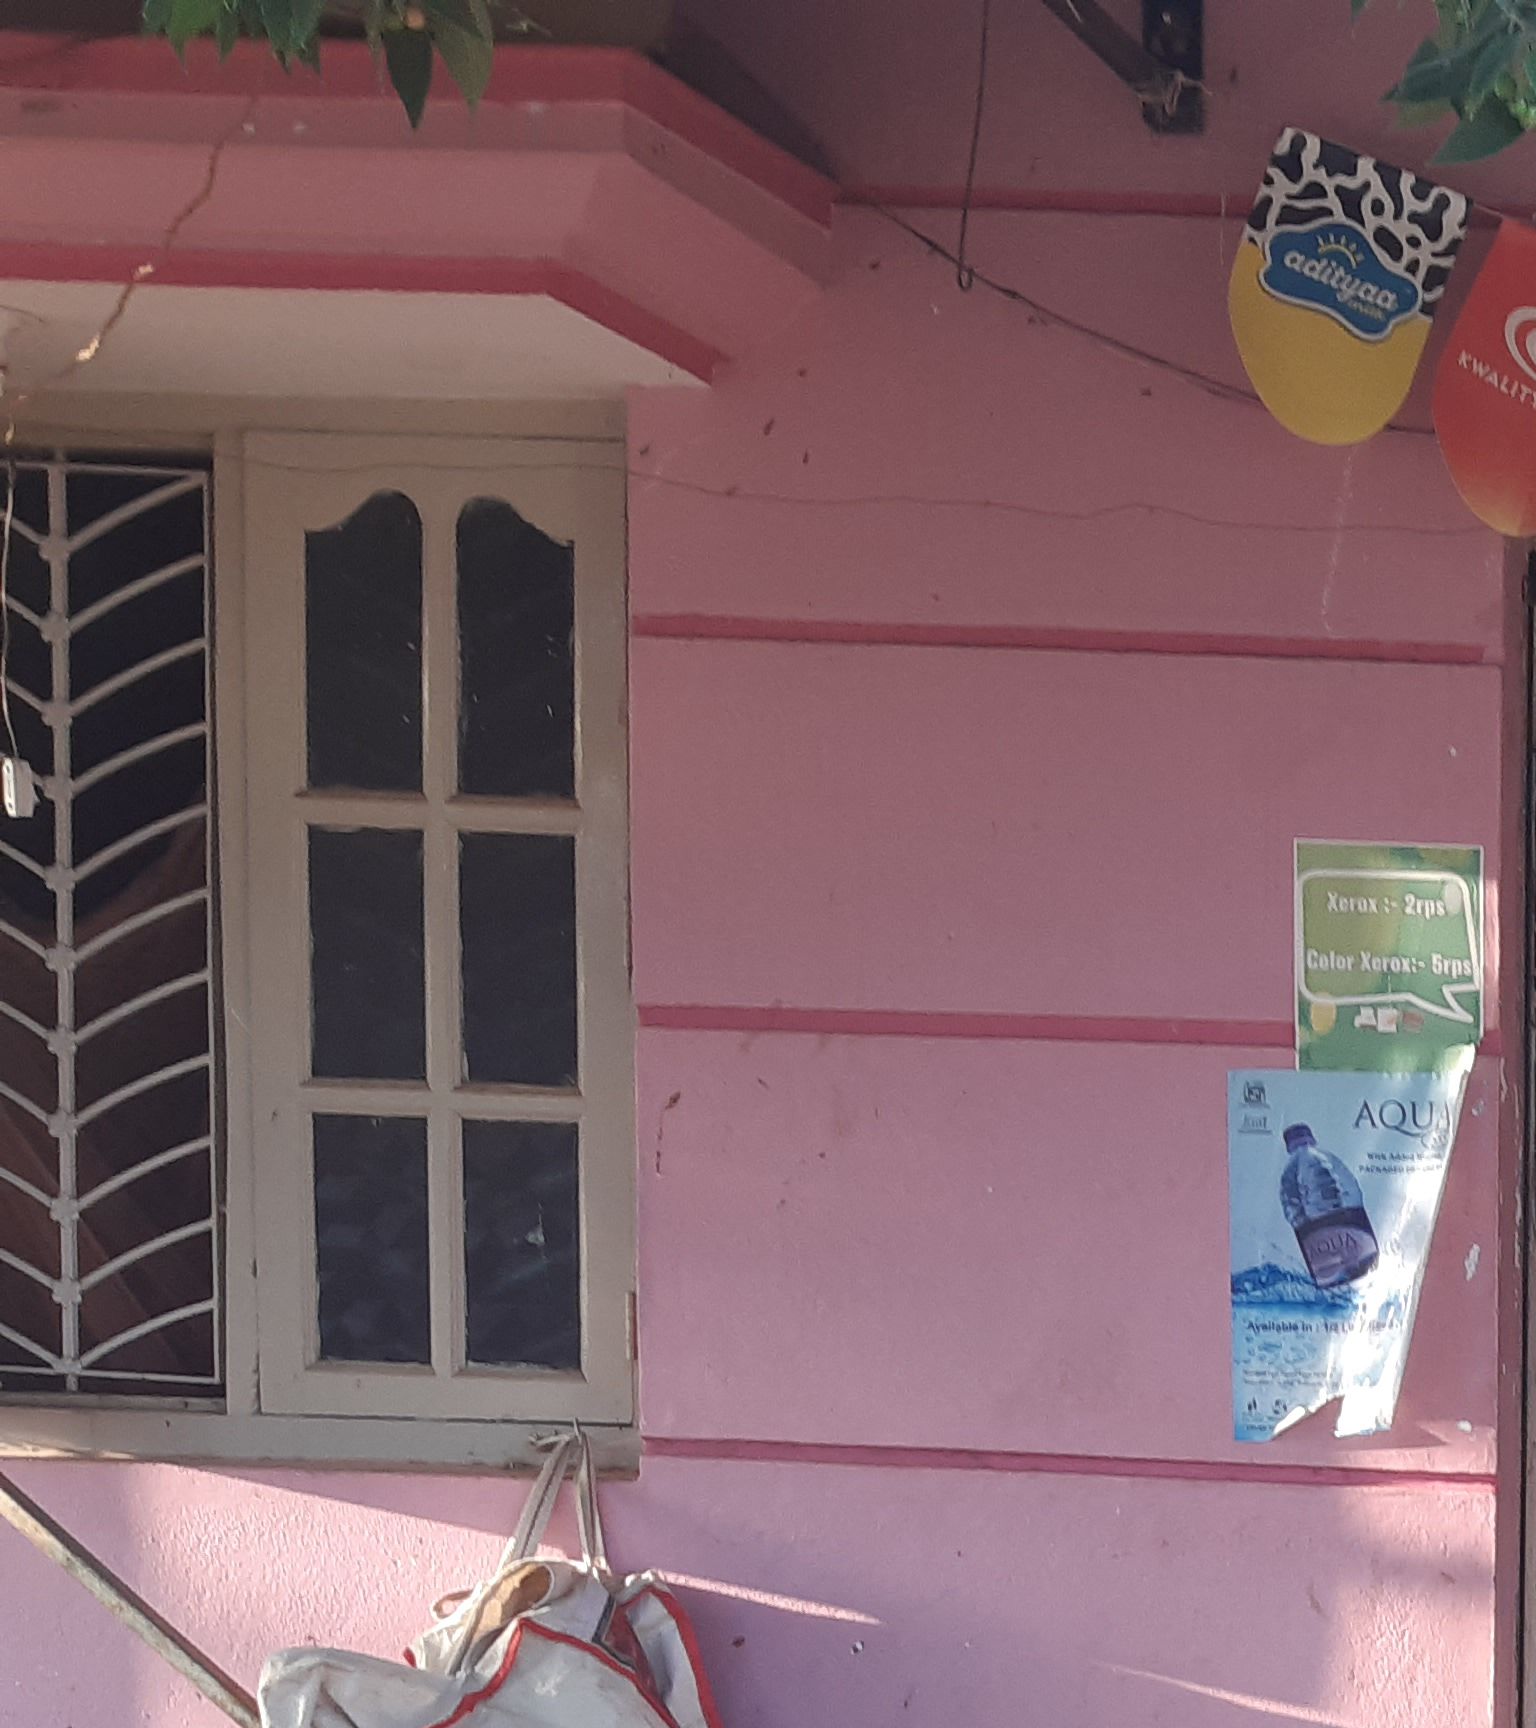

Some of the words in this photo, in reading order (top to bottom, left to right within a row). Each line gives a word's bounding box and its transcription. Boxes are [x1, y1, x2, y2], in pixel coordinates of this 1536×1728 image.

[1284, 250, 1398, 310] adityaa
[1326, 891, 1379, 914] Xerox
[1404, 892, 1447, 921] 2rps
[1306, 947, 1355, 972] Color
